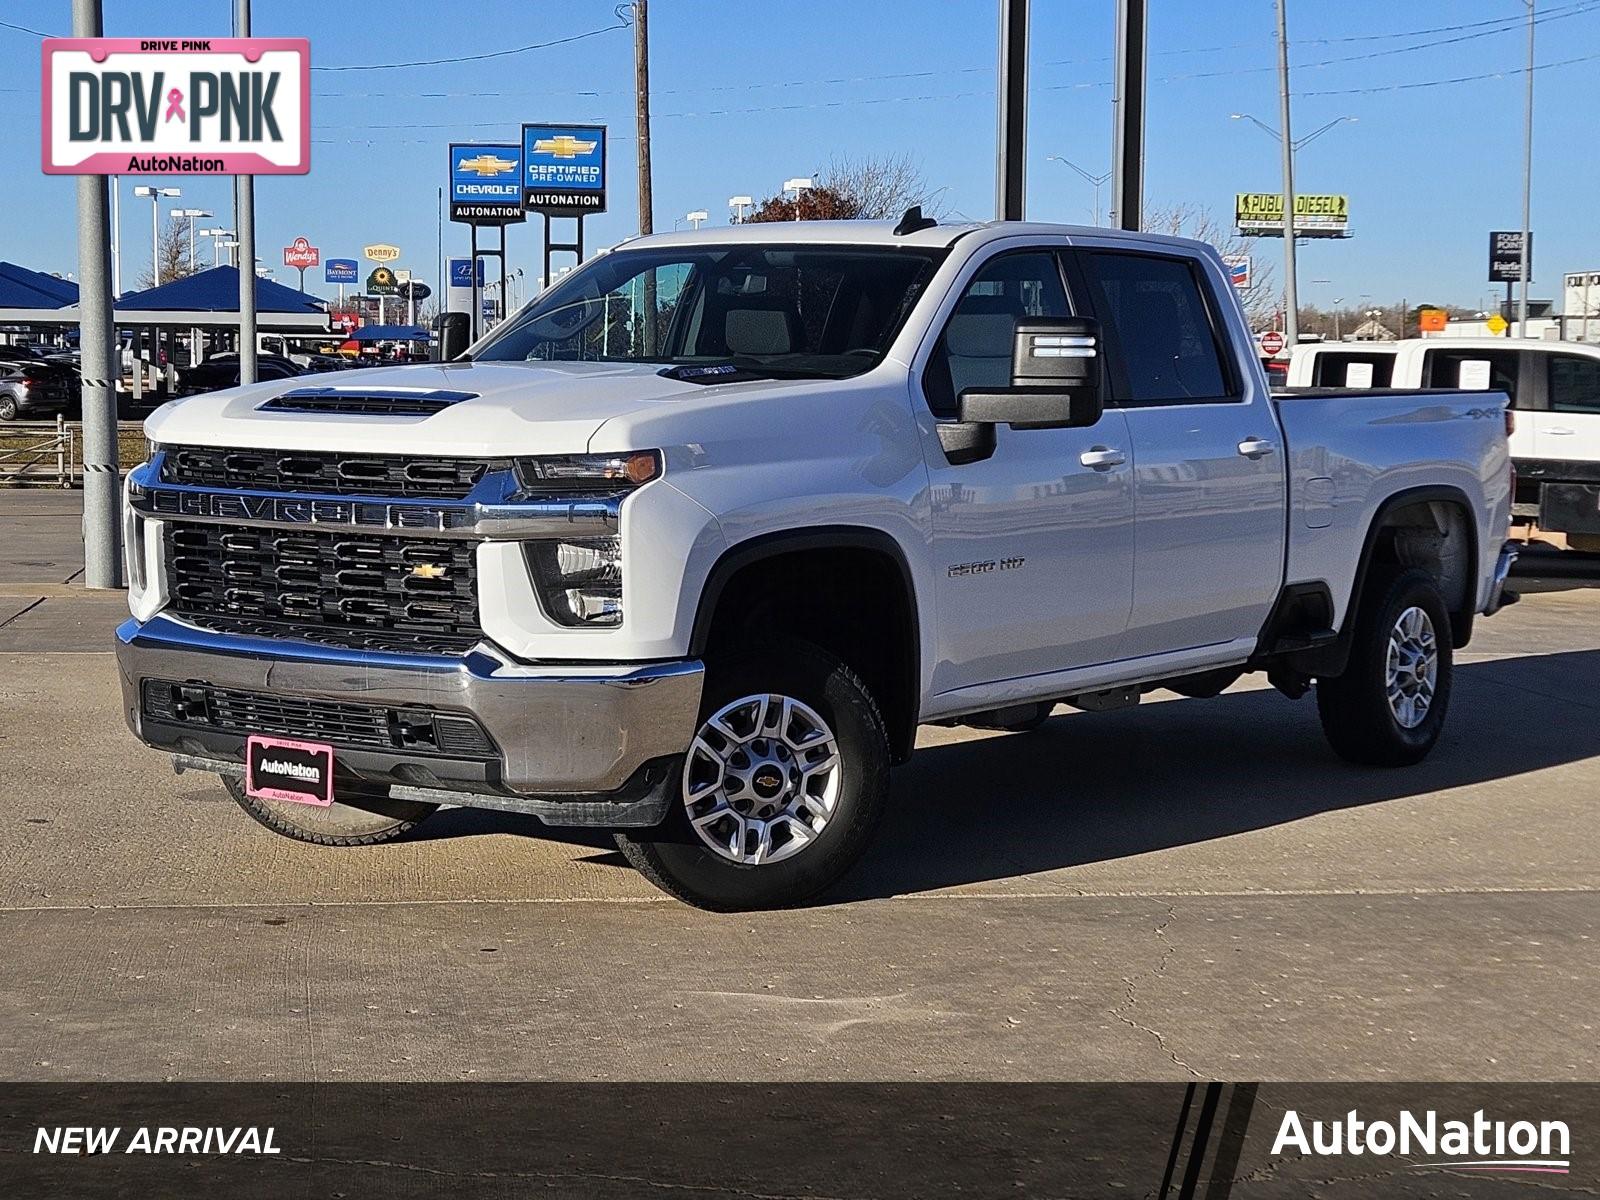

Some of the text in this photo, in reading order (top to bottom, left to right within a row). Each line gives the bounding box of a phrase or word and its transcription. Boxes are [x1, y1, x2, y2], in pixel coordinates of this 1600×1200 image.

[528, 164, 600, 175] CERTIFIED
[532, 174, 596, 183] PRE-OWNED
[456, 184, 519, 195] CHEVROLET
[529, 194, 600, 206] AUTONATION
[1252, 196, 1336, 213] PUBLI DIESEL
[456, 207, 521, 217] AUTONATION
[1497, 241, 1523, 249] POINT
[285, 250, 318, 263] Wendy's
[367, 247, 398, 258] Denny's
[326, 268, 357, 276] BAYMONT
[153, 490, 466, 532] CHEVROLET
[260, 758, 320, 779] AutoNation
[272, 791, 303, 801] AutoNation
